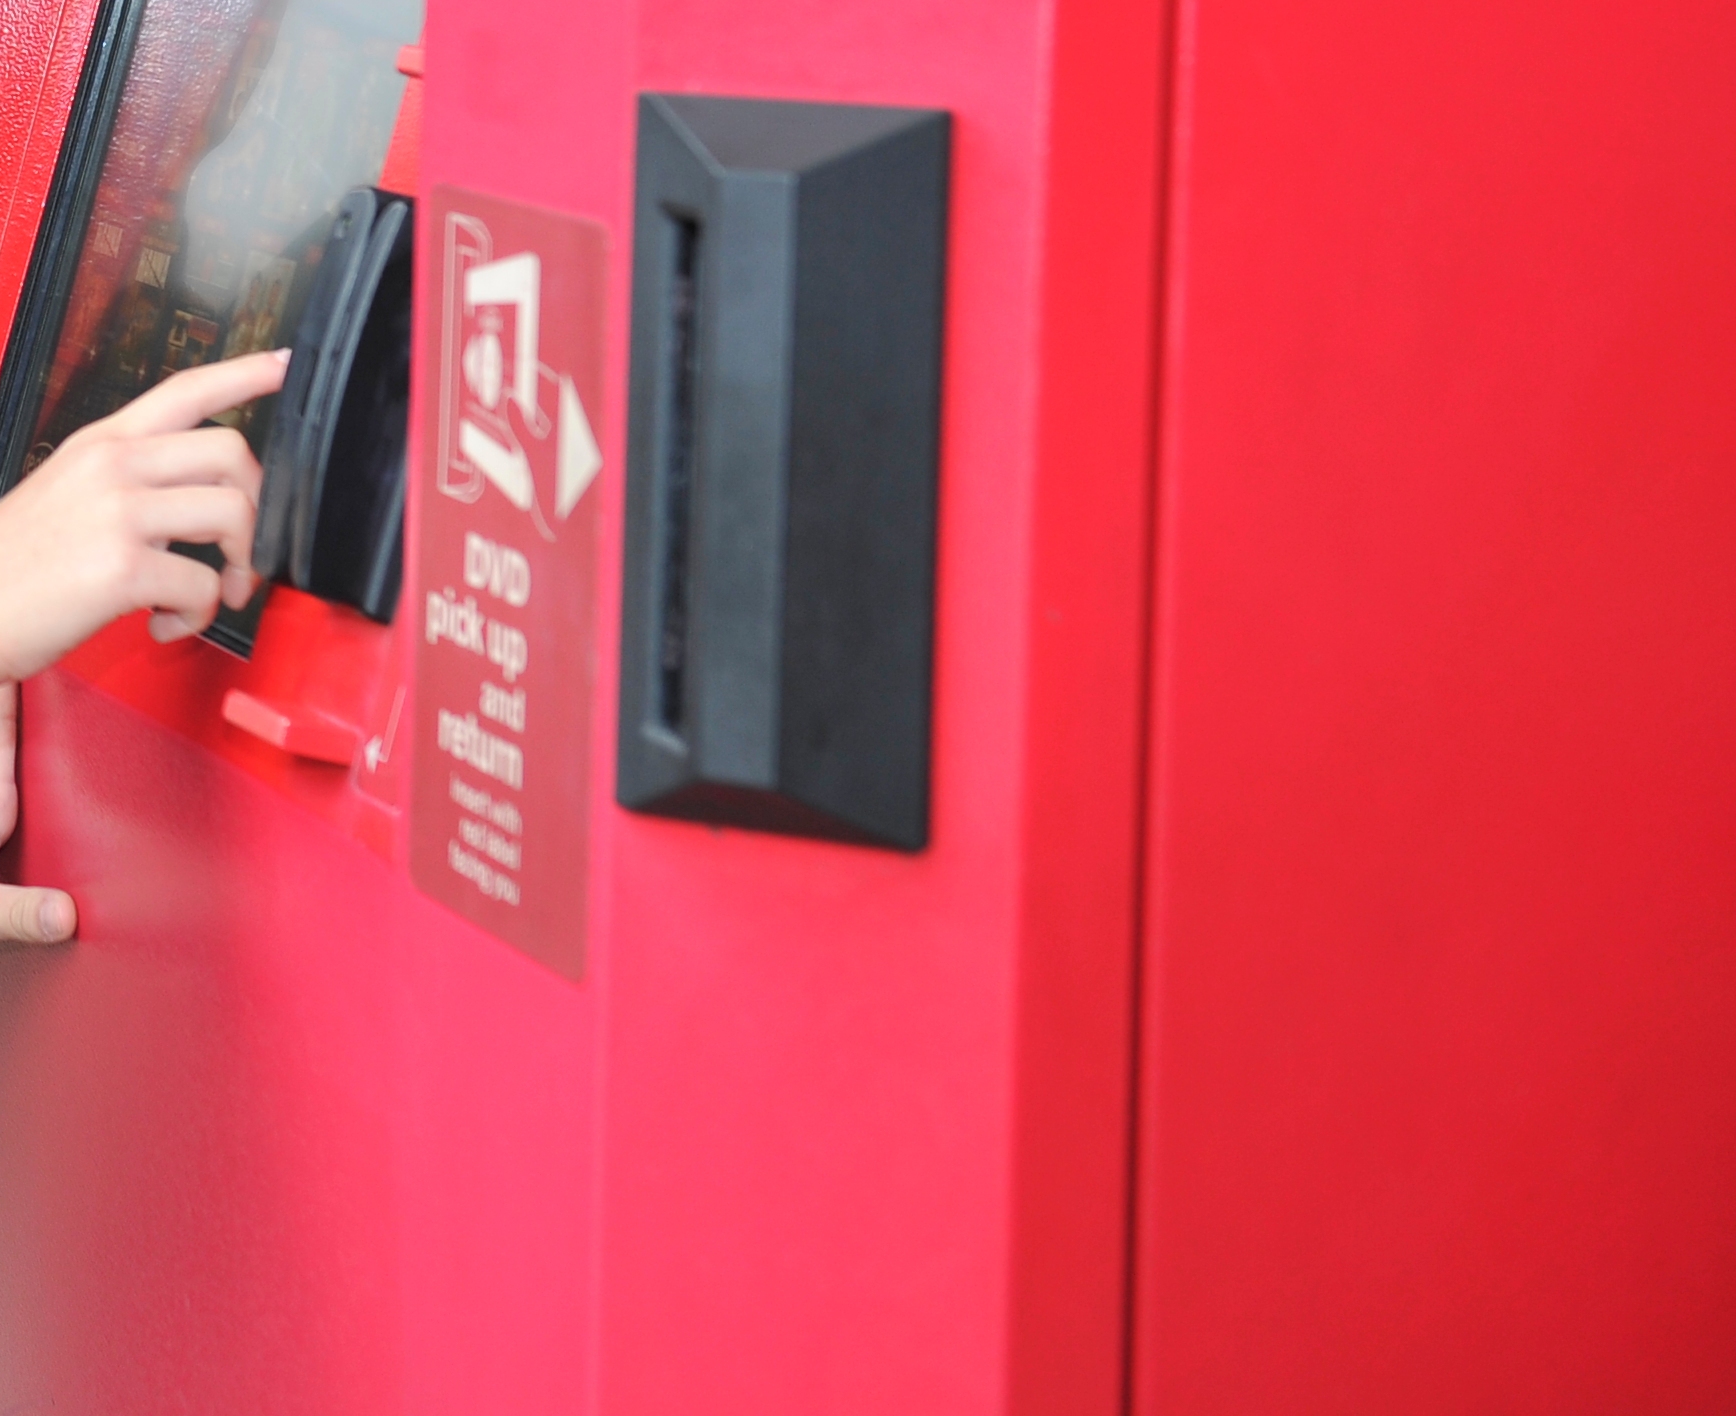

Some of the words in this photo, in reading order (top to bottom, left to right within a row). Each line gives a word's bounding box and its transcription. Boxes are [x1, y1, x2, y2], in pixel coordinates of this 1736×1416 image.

[463, 530, 532, 608] DVD
[425, 584, 486, 657] pick
[486, 618, 529, 683] up
[479, 680, 527, 734] and
[437, 706, 525, 792] return
